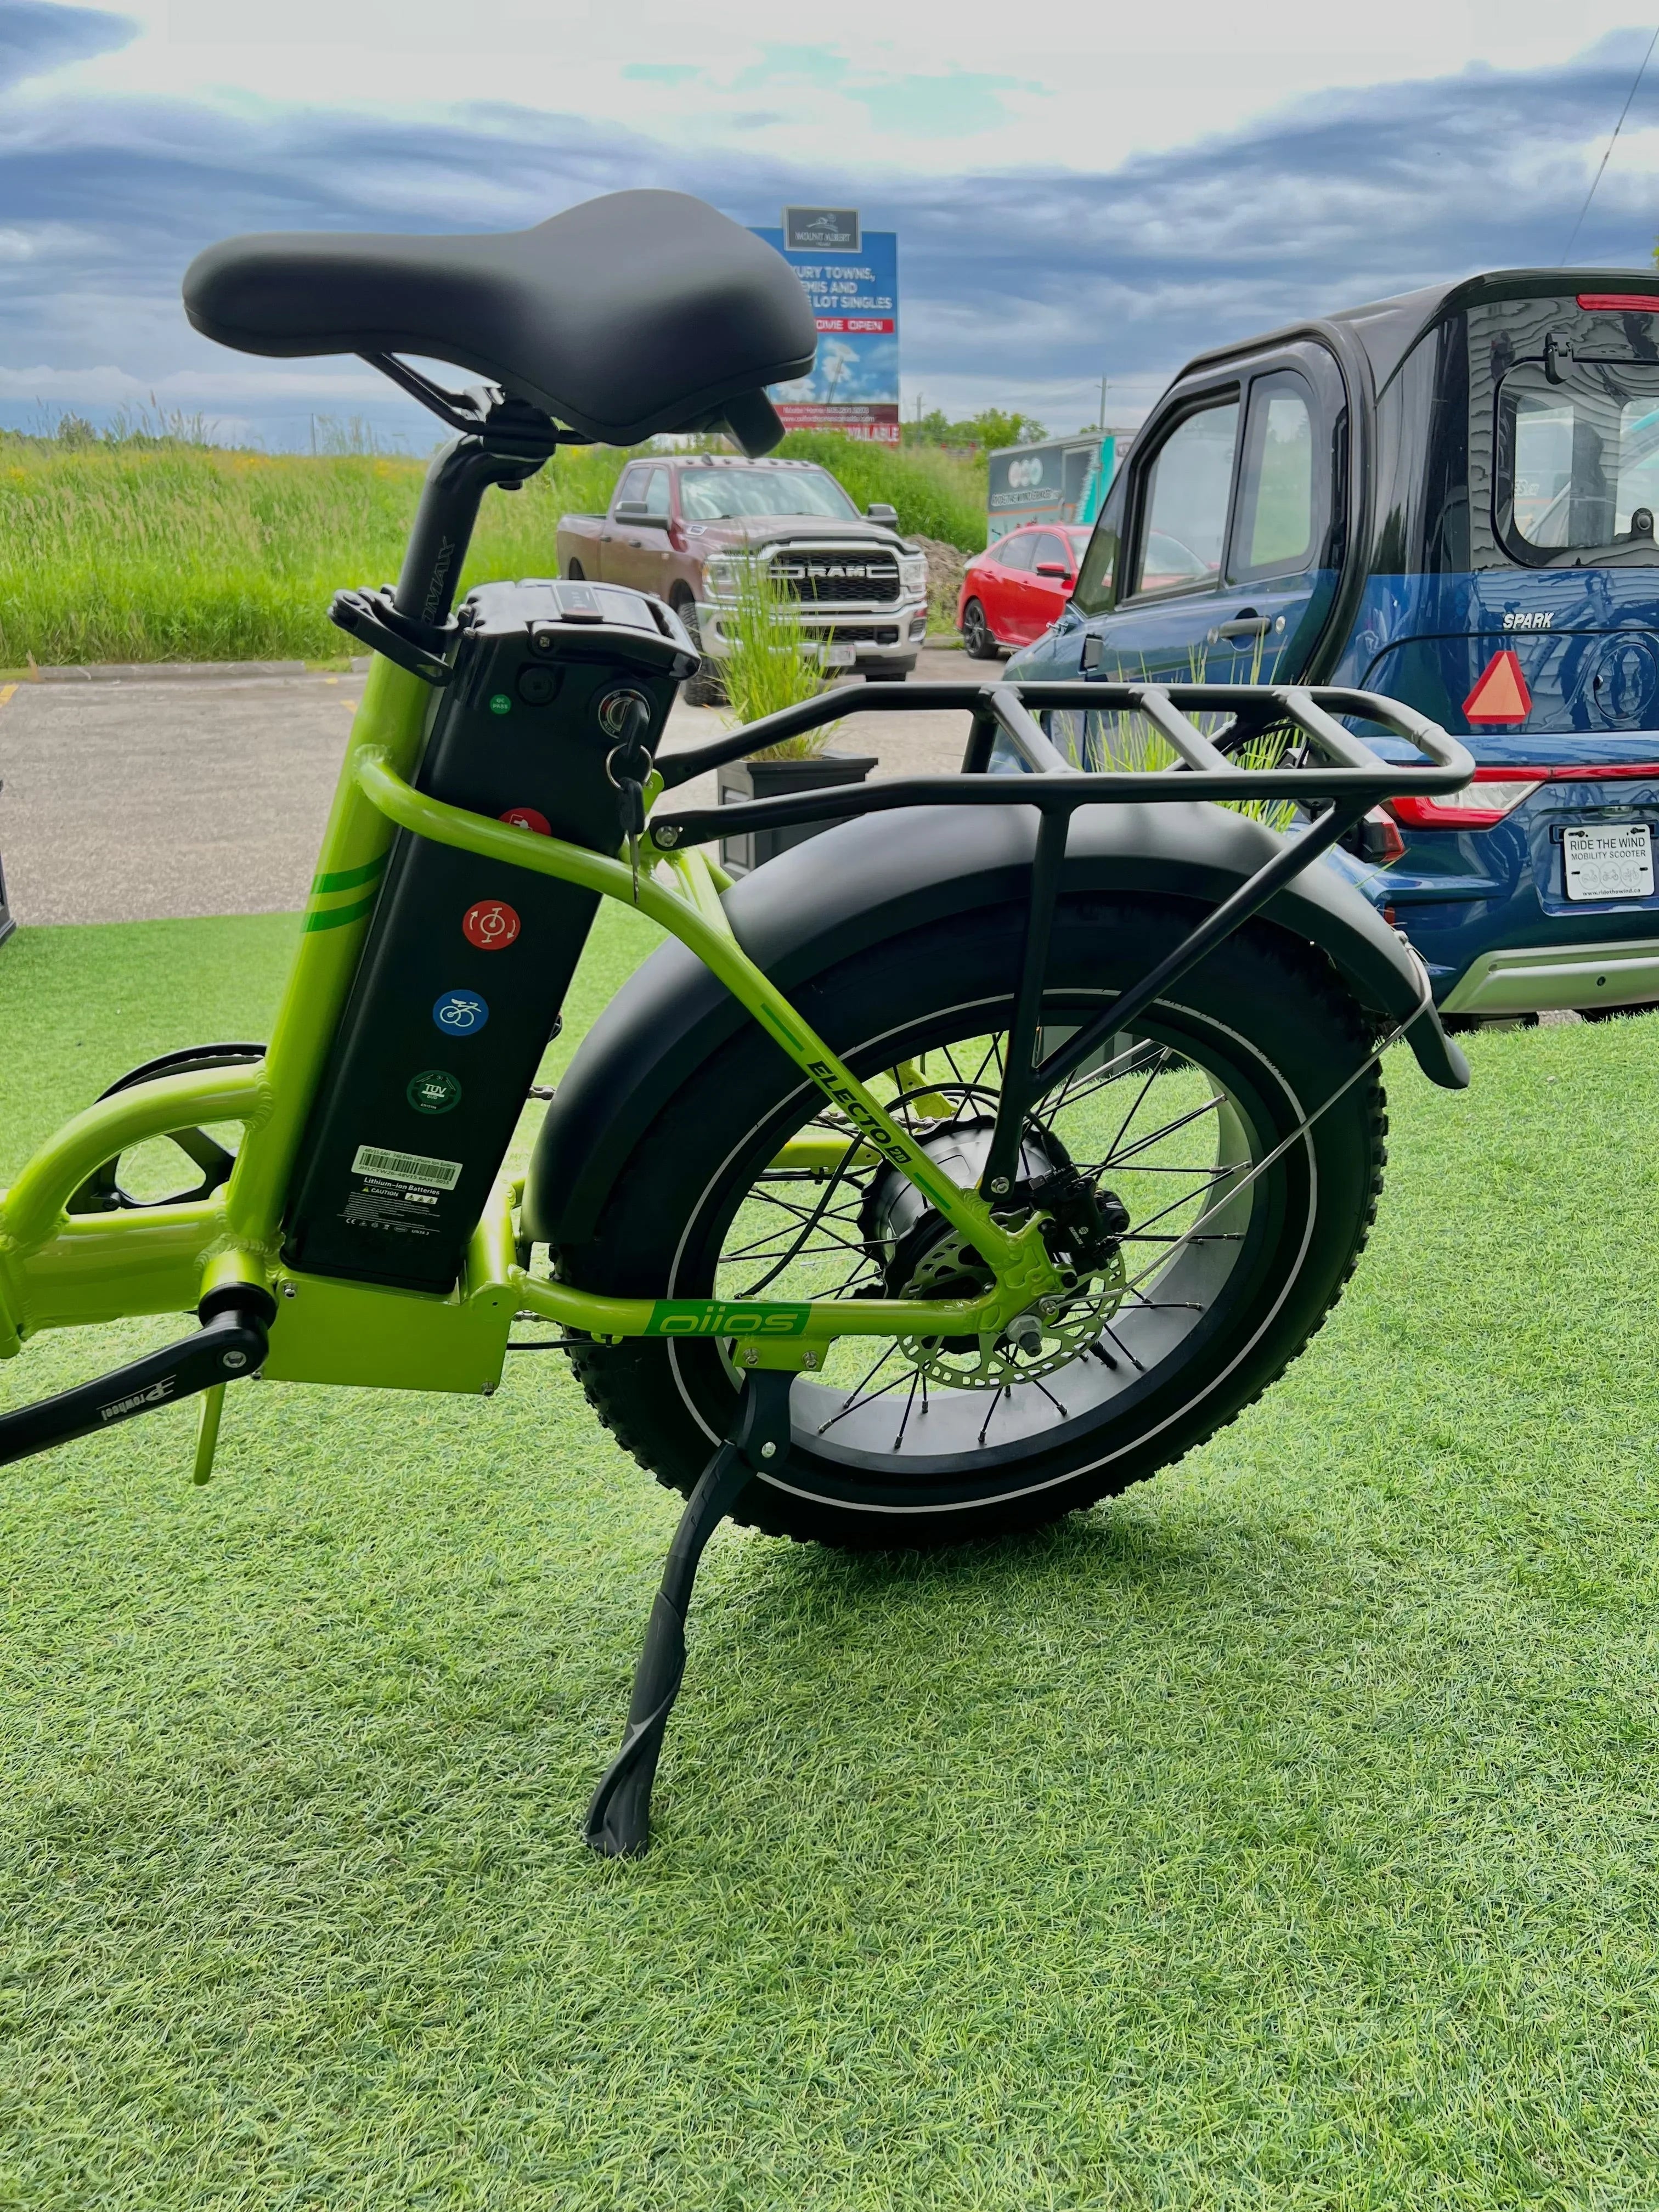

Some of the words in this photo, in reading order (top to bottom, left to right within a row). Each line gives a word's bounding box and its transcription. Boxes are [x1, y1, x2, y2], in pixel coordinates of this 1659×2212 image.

[830, 281, 858, 294] AND
[813, 295, 839, 308] LOT
[840, 296, 893, 309] SINGLES
[848, 320, 883, 330] OPEN
[807, 566, 866, 577] RAM
[1503, 612, 1554, 629] SPARK
[1570, 840, 1594, 851] RIDE
[1596, 838, 1617, 849] THE
[1620, 837, 1645, 848] WIND
[1571, 851, 1607, 861] MOBILITY
[1610, 850, 1646, 859] SCOOTER
[806, 1060, 891, 1144] ELECTO
[364, 1177, 407, 1190] Lithium-ion
[408, 1184, 441, 1195] Batteries
[371, 1188, 399, 1197] CAUTION
[659, 1306, 798, 1333] oiios
[101, 1378, 171, 1421] Prowheel
